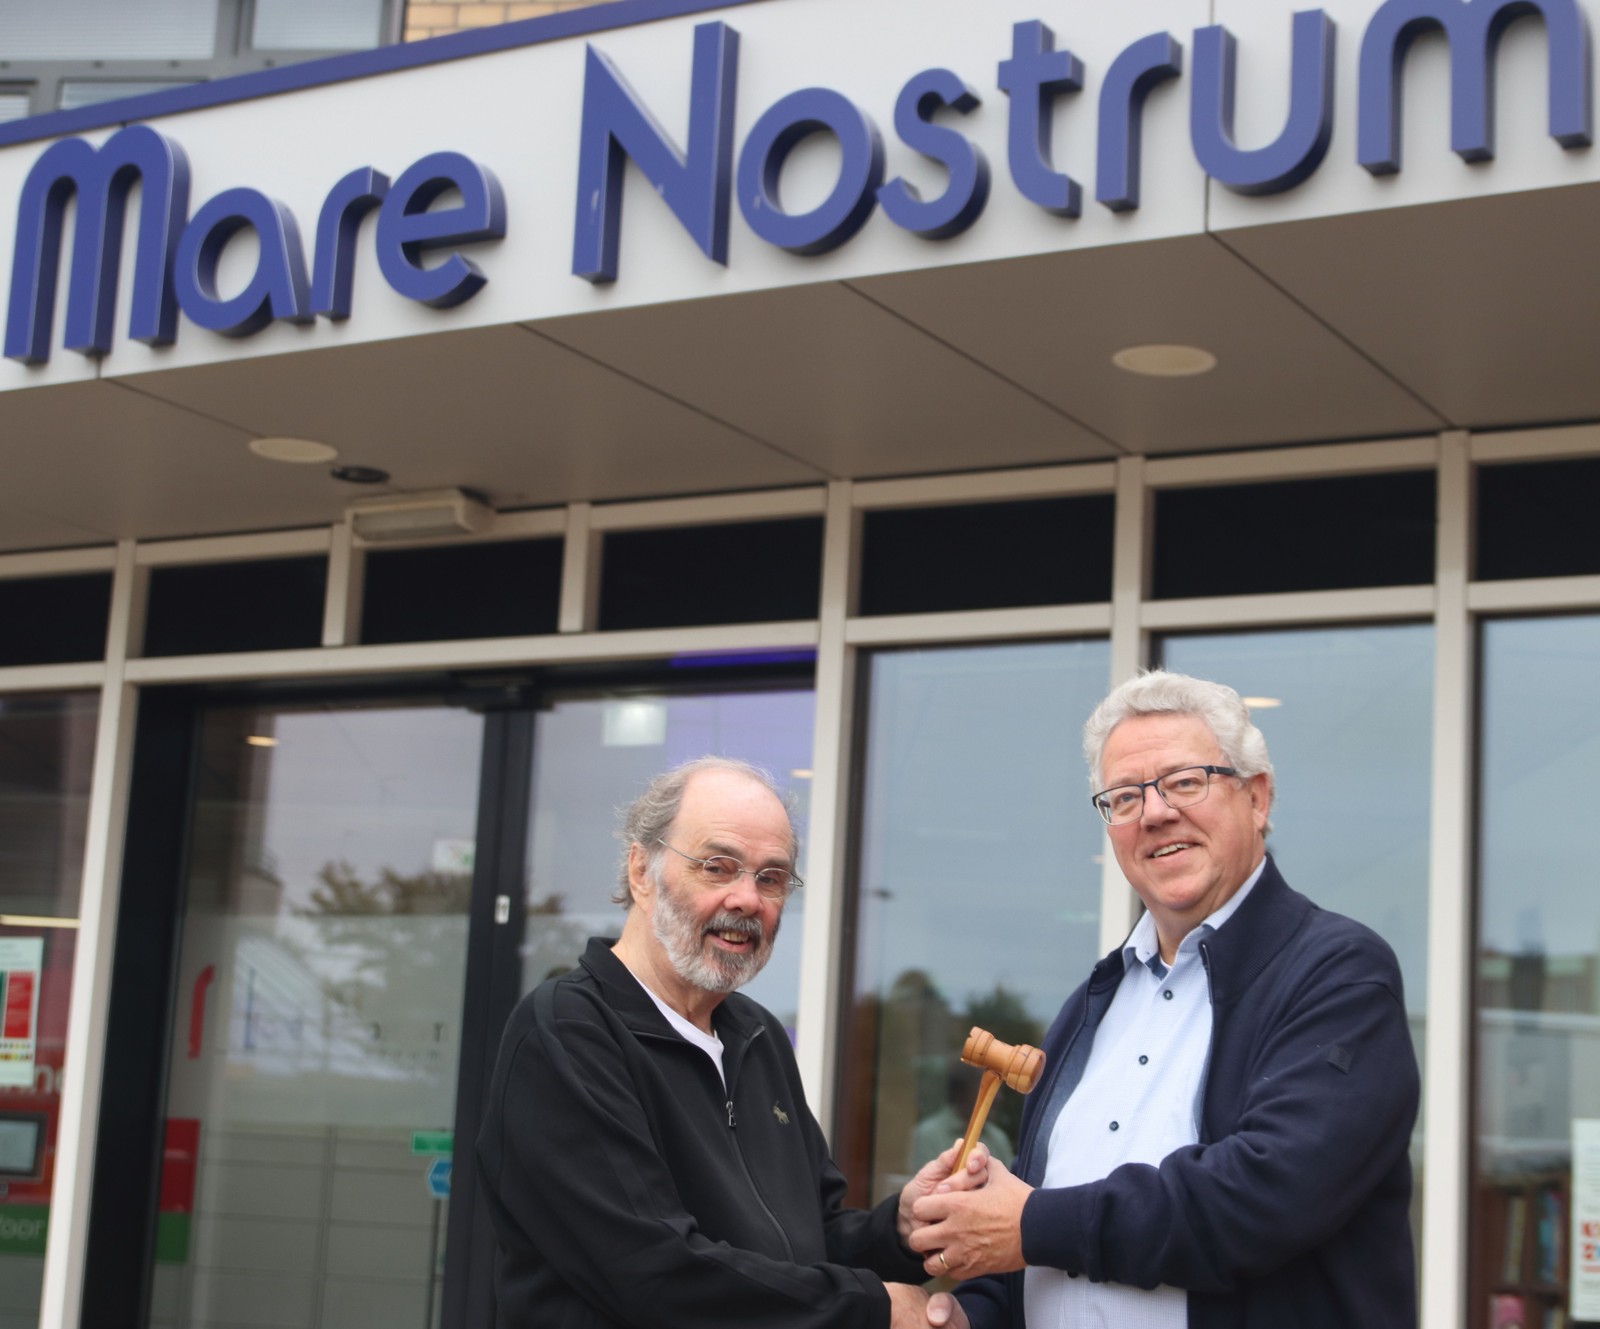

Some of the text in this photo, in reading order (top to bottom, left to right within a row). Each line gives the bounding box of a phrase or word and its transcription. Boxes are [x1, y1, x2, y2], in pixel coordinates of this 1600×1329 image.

[4, 0, 1593, 370] Mare Nostrum
[0, 1212, 46, 1240] oor
